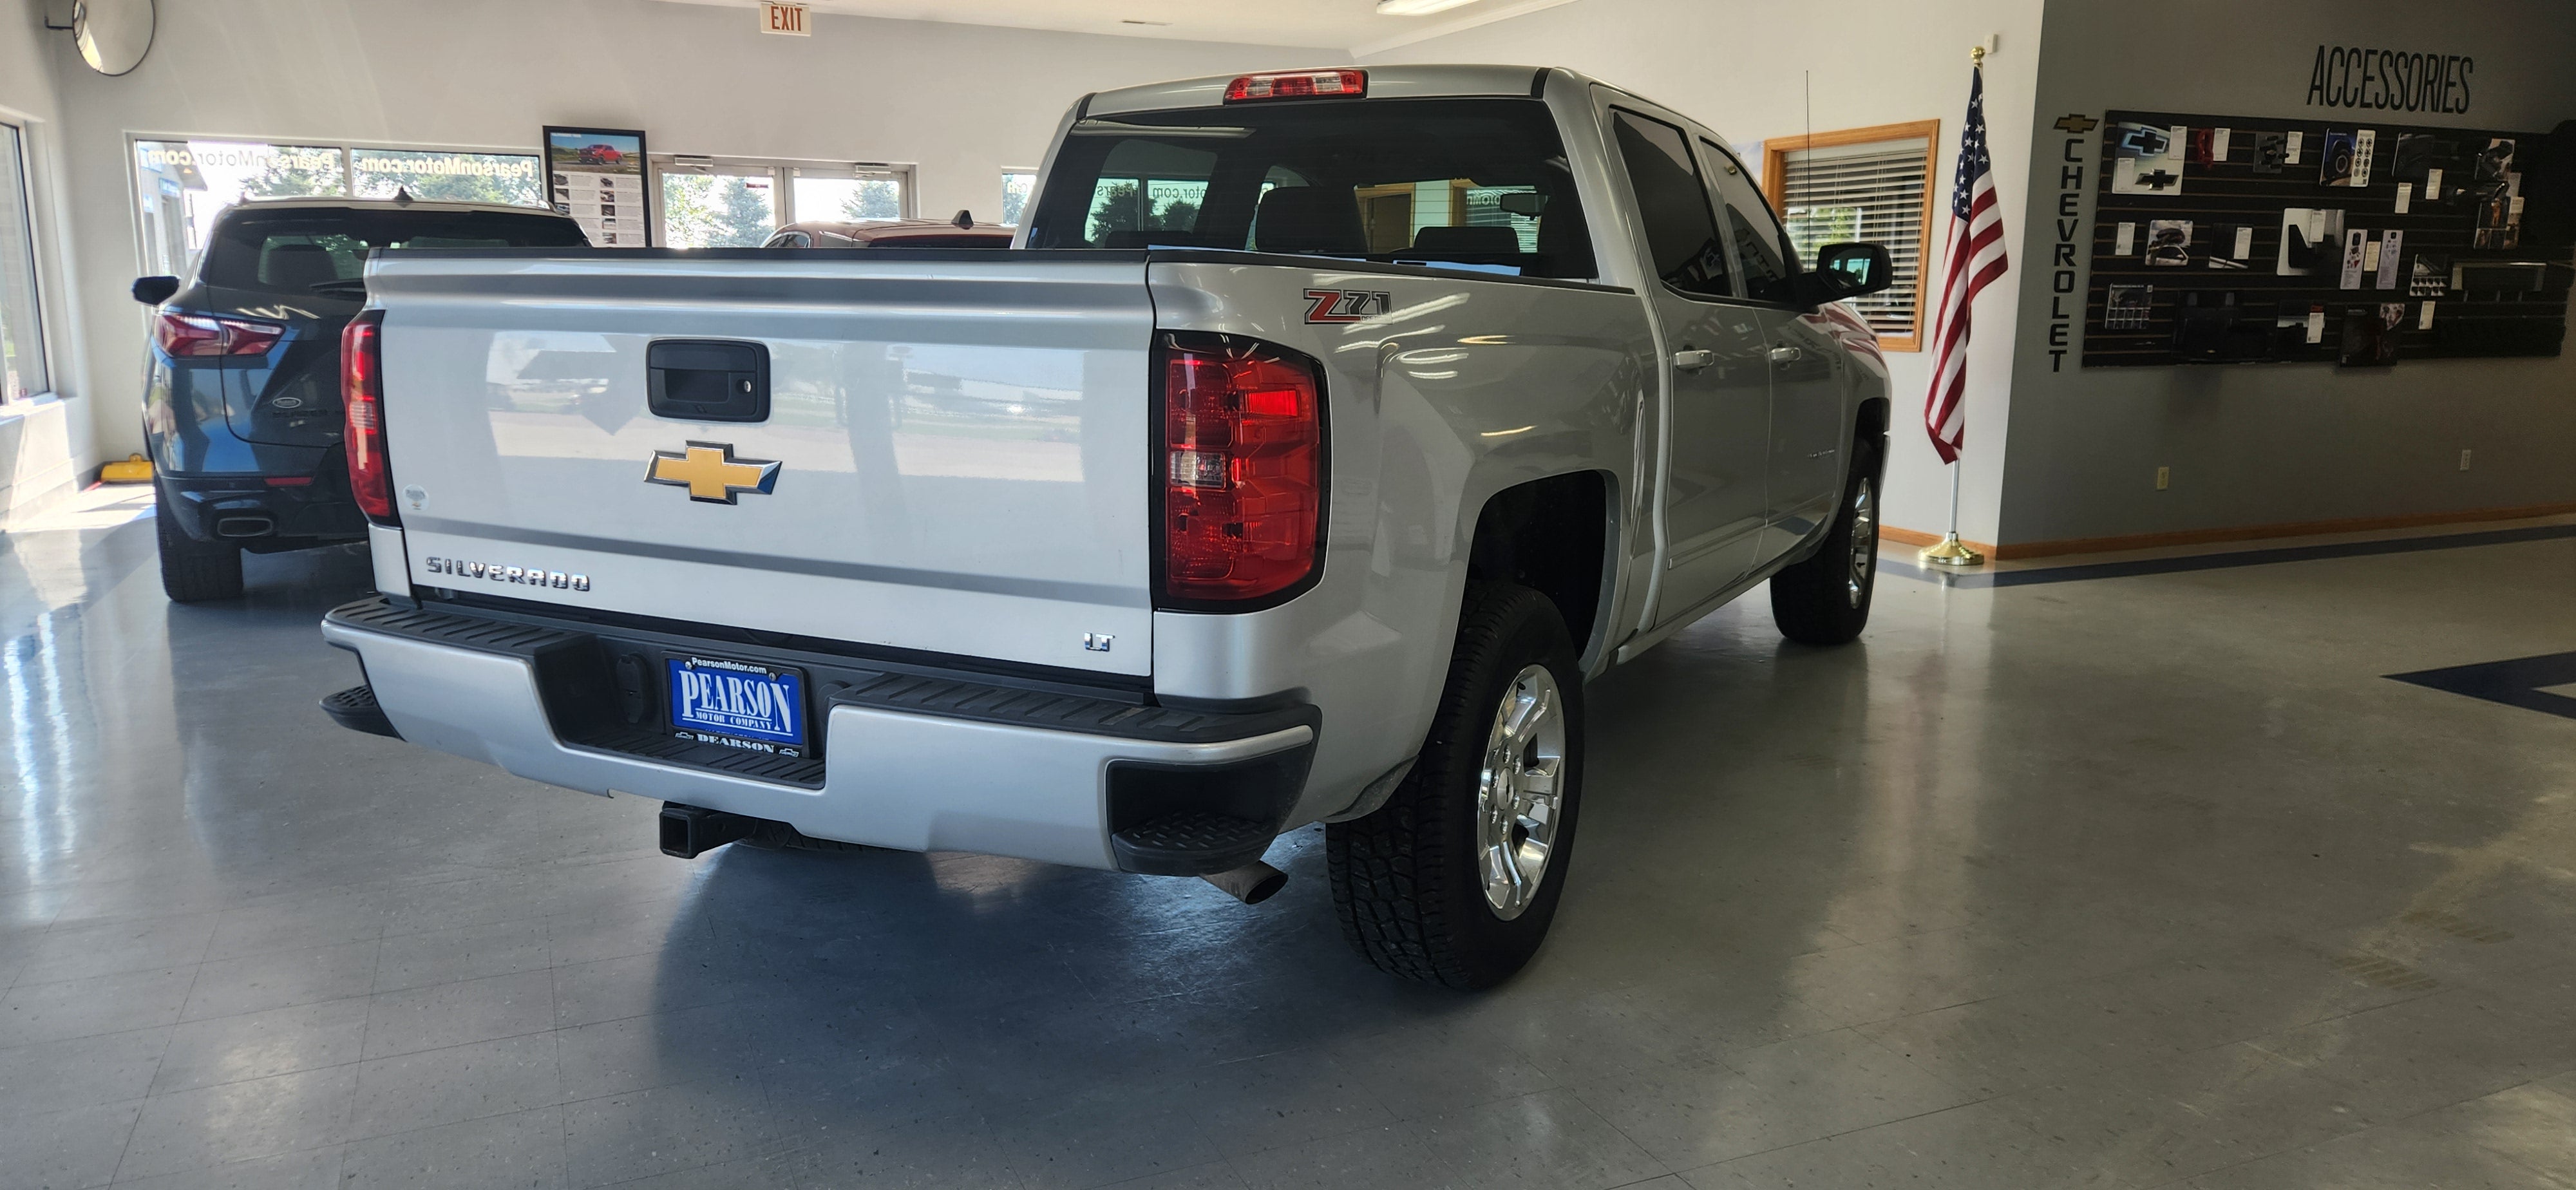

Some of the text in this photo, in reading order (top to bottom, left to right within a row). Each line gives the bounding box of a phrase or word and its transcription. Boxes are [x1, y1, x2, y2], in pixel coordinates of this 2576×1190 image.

[770, 5, 802, 32] EXIT
[2306, 45, 2474, 114] ACCESSORIES
[2049, 138, 2085, 372] CHEVROLET
[1303, 288, 1393, 325] Z71
[426, 556, 591, 592] SILVERADO
[1084, 632, 1115, 652] LT
[691, 657, 767, 674] PearsonMotor.com
[679, 670, 791, 733] PEARSON
[696, 711, 773, 730] MOTOR COMPANY
